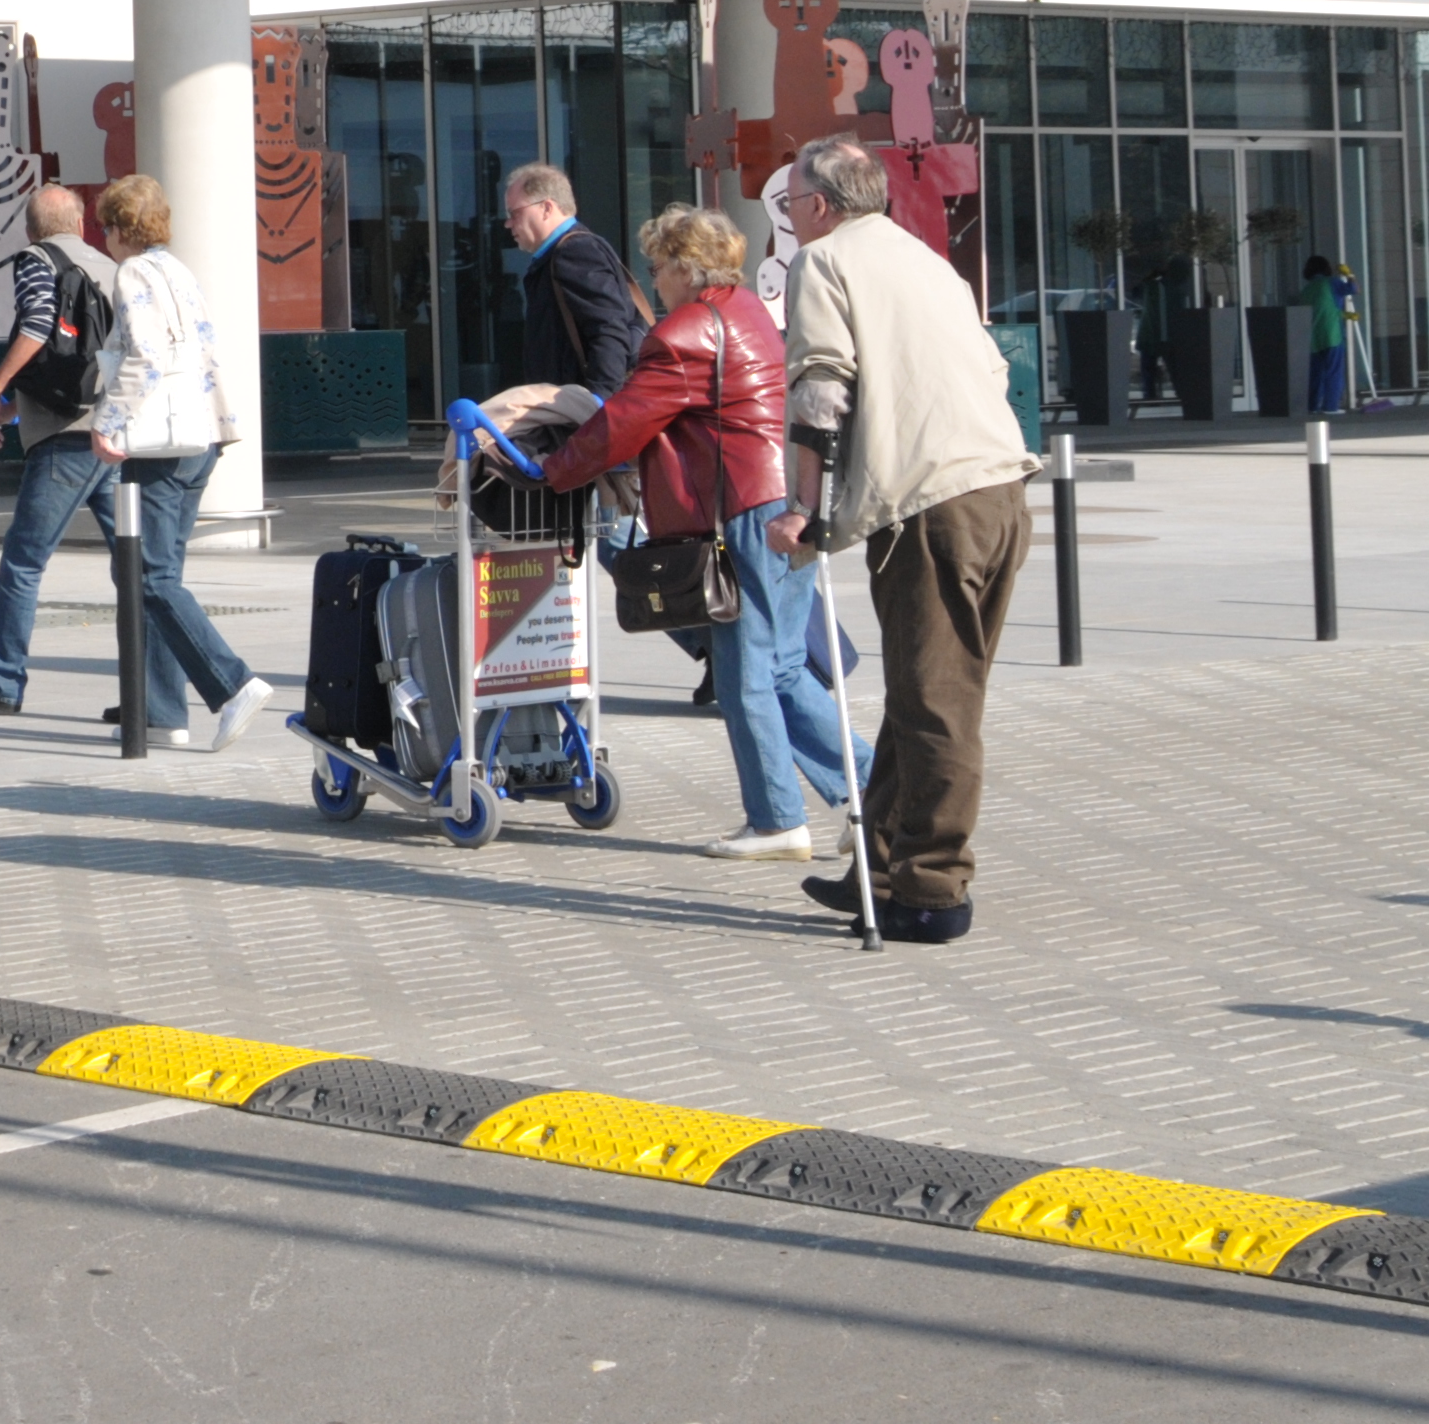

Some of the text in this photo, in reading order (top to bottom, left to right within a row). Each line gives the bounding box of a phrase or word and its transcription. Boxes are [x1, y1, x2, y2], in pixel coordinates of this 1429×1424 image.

[479, 559, 544, 581] Kleanthis
[479, 585, 520, 606] Savva
[554, 596, 581, 607] Quality
[528, 618, 542, 629] you
[516, 633, 543, 646] People
[545, 633, 559, 645] you
